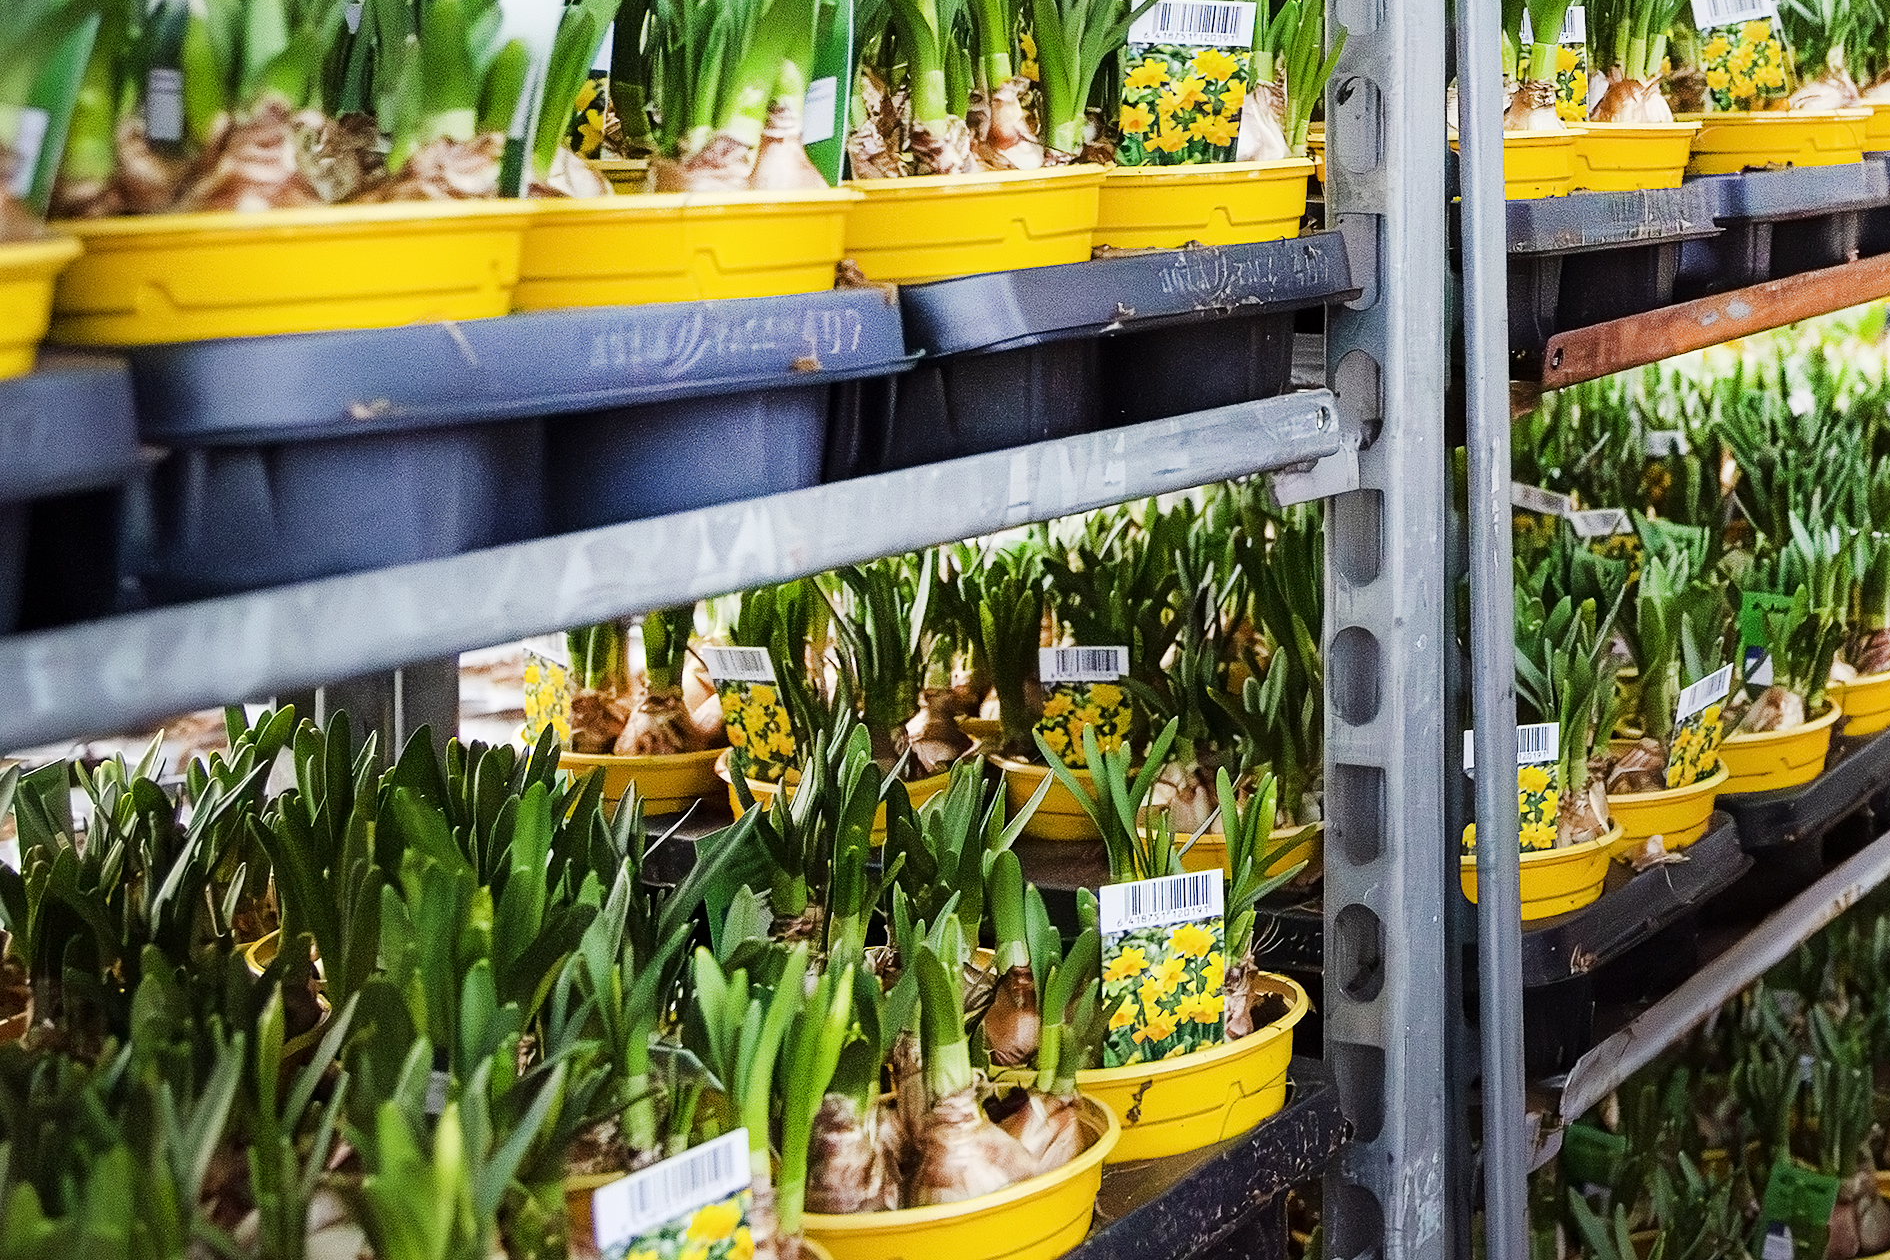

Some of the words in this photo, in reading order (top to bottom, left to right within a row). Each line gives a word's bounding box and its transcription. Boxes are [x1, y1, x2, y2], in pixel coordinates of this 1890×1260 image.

[1200, 33, 1235, 42] 120191
[1116, 919, 1123, 927] 6
[1128, 912, 1166, 925] 418751
[1173, 905, 1209, 918] 120191
